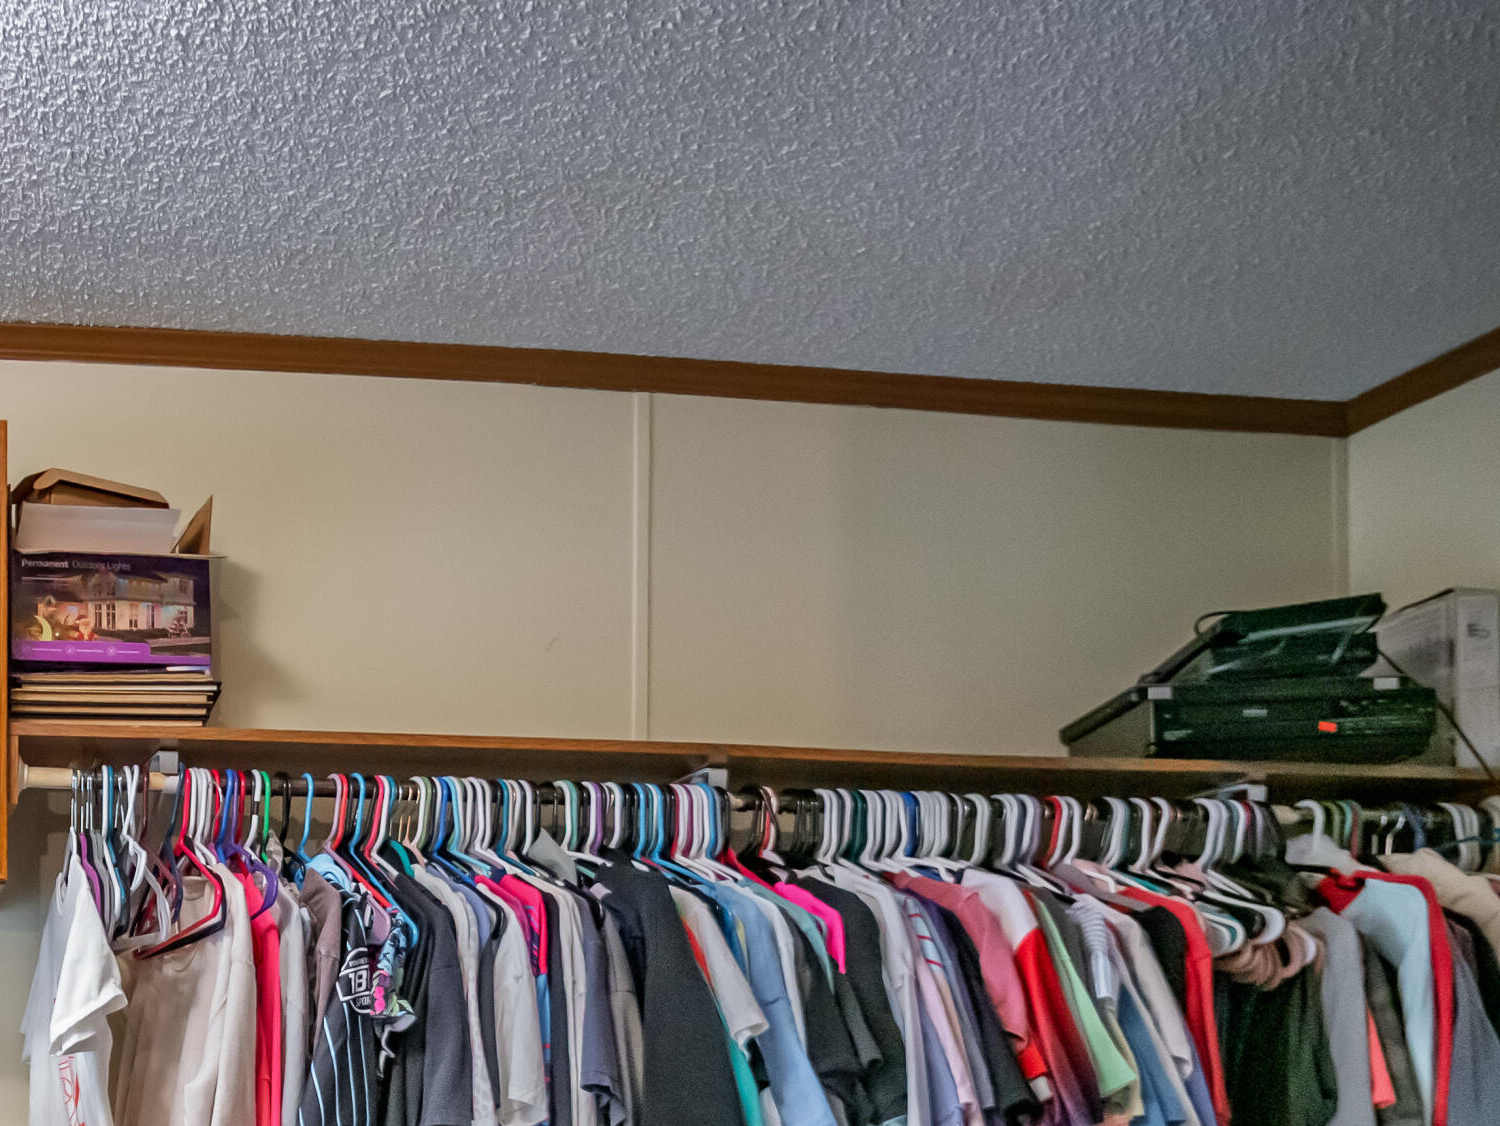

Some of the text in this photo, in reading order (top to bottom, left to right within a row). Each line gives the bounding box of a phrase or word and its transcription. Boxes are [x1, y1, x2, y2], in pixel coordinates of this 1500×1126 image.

[21, 558, 69, 569] Permanent
[107, 560, 131, 572] Lights
[349, 970, 367, 994] 18
